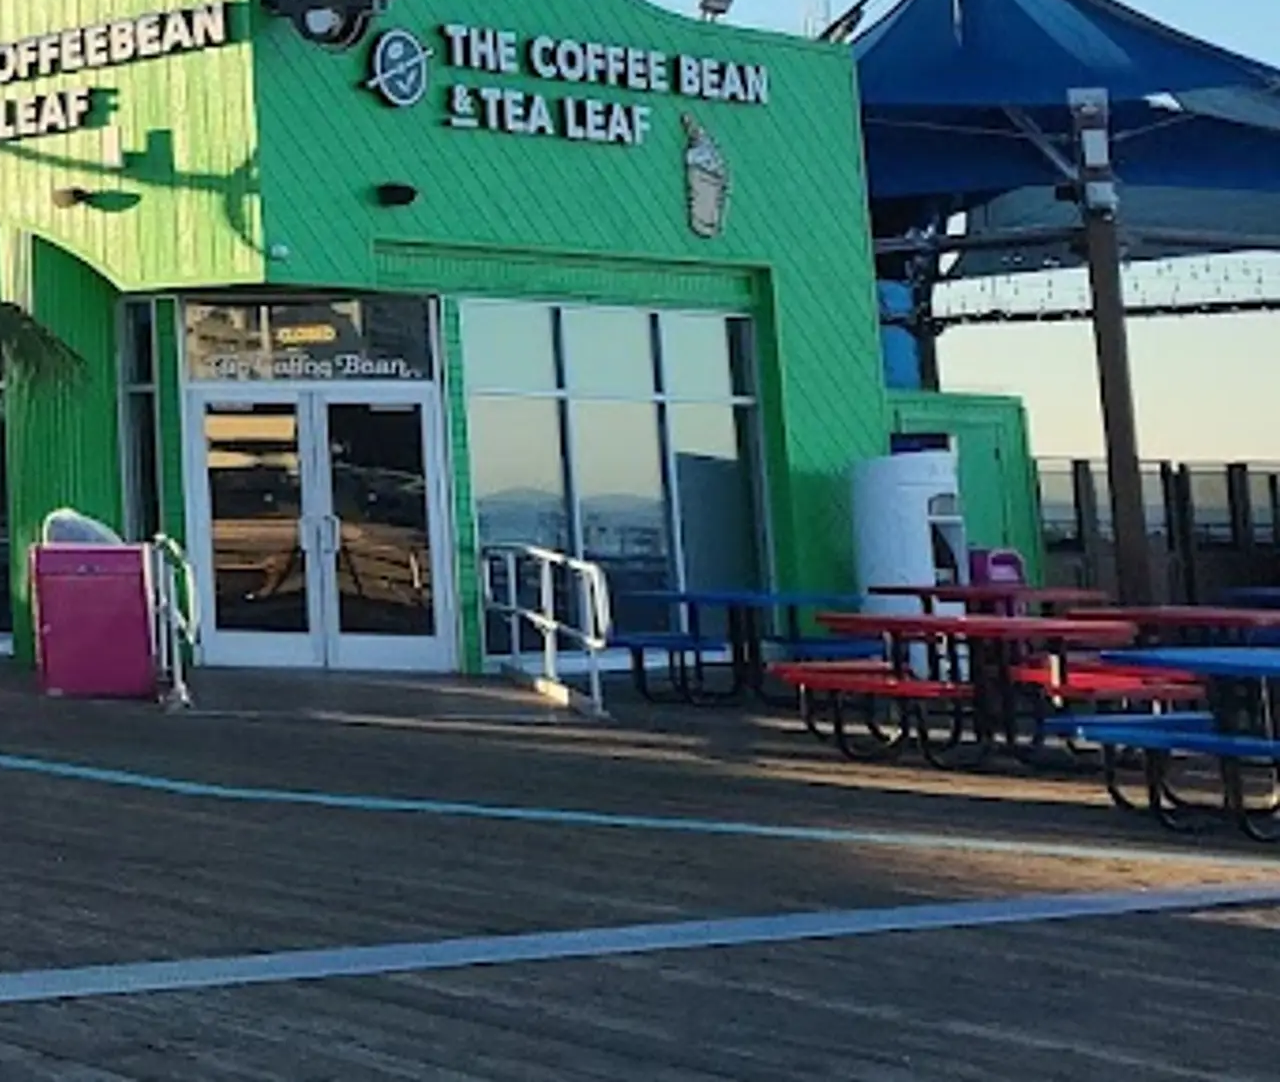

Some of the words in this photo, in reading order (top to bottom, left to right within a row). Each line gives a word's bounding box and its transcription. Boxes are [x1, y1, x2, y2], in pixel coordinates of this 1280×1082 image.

[444, 23, 519, 73] THE
[529, 35, 670, 91] COFFEE
[679, 53, 769, 105] BEAN
[451, 84, 477, 122] &
[481, 86, 555, 135] TEA
[563, 96, 652, 145] LEAF
